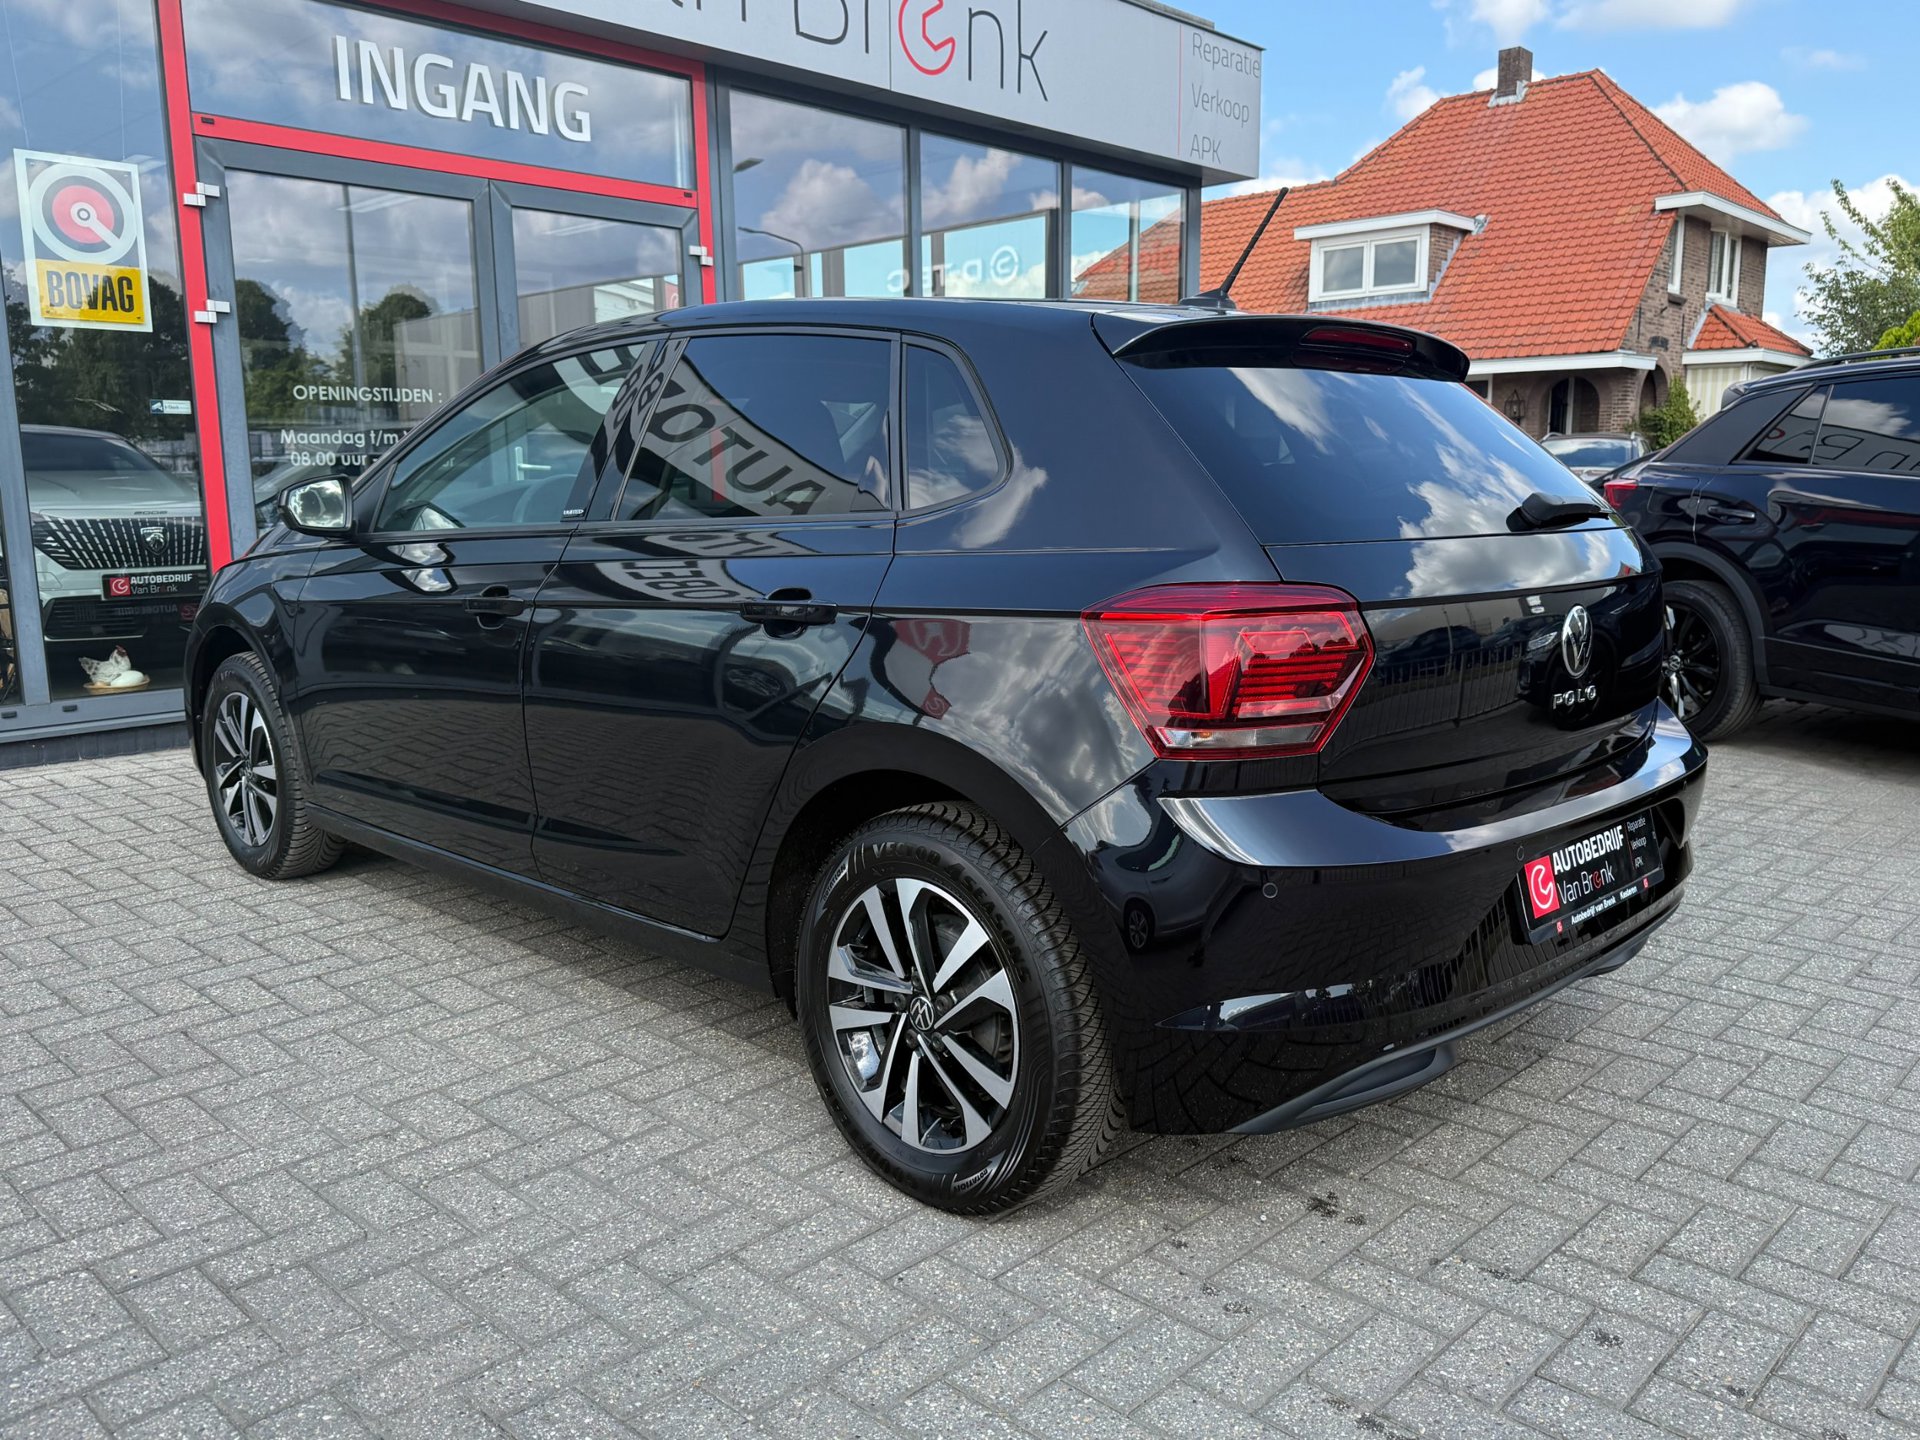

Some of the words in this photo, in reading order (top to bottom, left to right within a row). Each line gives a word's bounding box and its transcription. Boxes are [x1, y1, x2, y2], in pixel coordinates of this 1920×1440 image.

[1192, 32, 1260, 79] Reparatie
[335, 34, 592, 142] INGANG
[1191, 82, 1249, 128] Verkoop
[1190, 134, 1222, 165] APK
[46, 270, 134, 312] BOVAG
[293, 385, 433, 403] OPENINGSTIJDEN
[280, 429, 366, 448] Maandag
[370, 430, 399, 447] t/m
[290, 451, 336, 466] 08.00
[341, 453, 368, 466] uur
[130, 573, 193, 585] AUTOBEDRIJF
[131, 585, 149, 595] Van
[1553, 685, 1596, 709] POLO
[1627, 816, 1646, 832] Reparatie
[1552, 825, 1625, 875] AUTOBEDRIJF
[1557, 879, 1582, 905] Van
